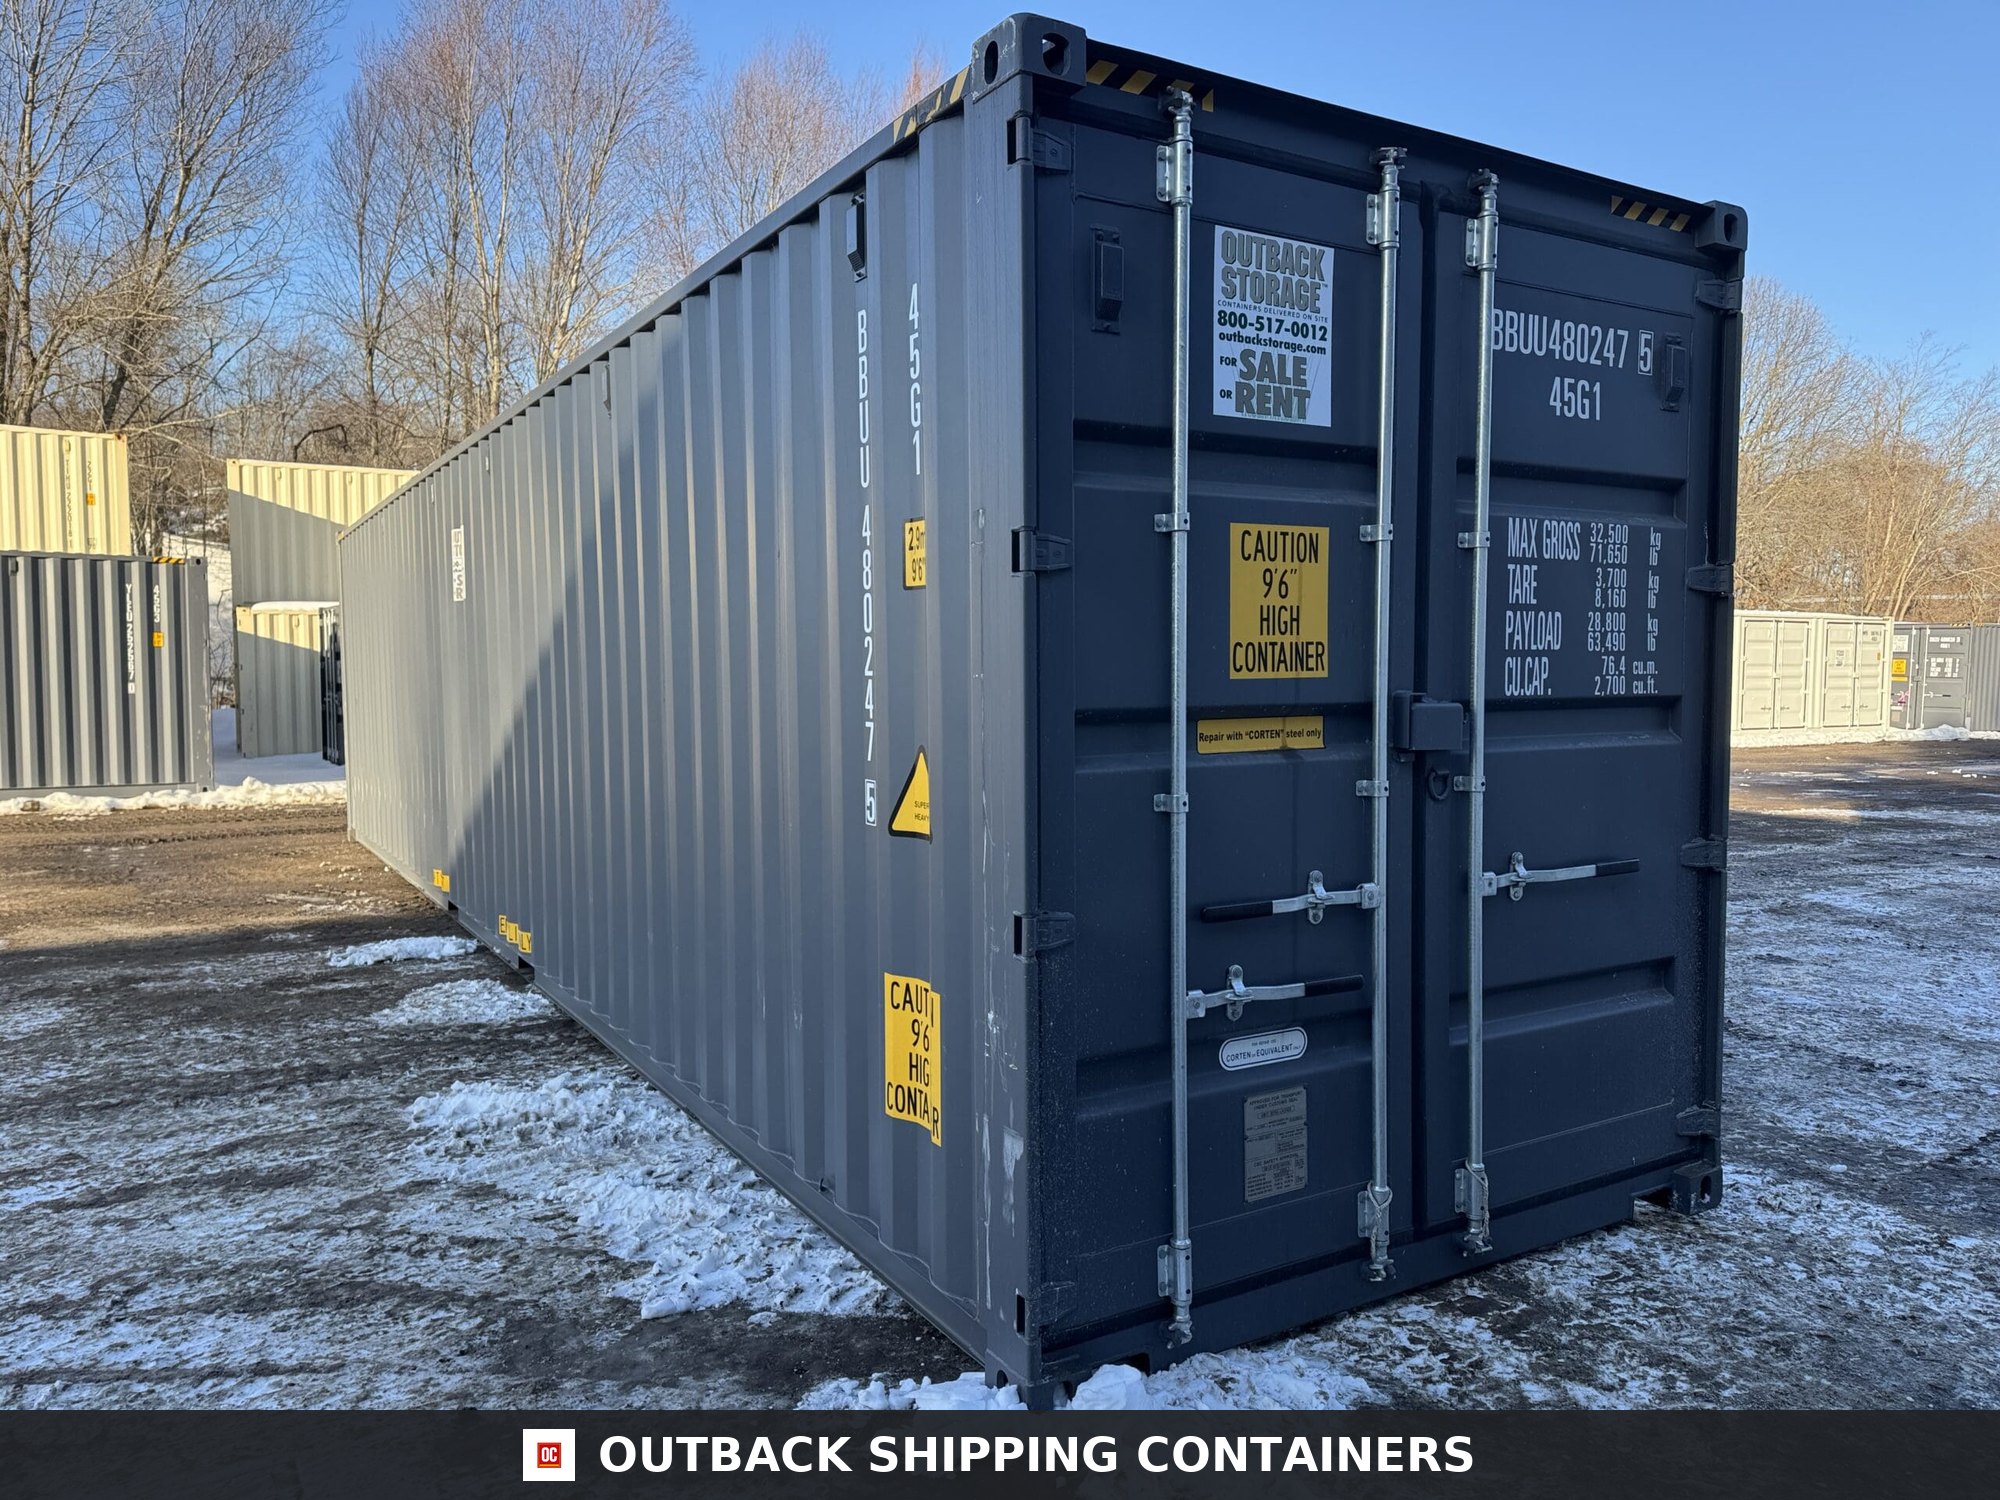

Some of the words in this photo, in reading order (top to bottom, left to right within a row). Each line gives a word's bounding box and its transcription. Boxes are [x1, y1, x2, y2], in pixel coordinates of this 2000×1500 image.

[1221, 230, 1326, 282] OUTBACK
[1221, 265, 1321, 314] STORAGE
[1217, 300, 1261, 312] CONTAINERS
[1264, 307, 1300, 319] DELIVERED
[1303, 313, 1312, 321] ON
[1217, 310, 1328, 341] 800-517-0012
[1218, 331, 1327, 355] outbackstorage.com
[1639, 332, 1652, 373] 5
[908, 282, 922, 475] 45G1
[1219, 355, 1237, 367] FOR
[1239, 348, 1307, 388] SALE
[857, 309, 870, 488] BBUU
[1219, 389, 1233, 400] OR
[1235, 381, 1311, 420] RENT
[1549, 376, 1600, 420] 45G1
[1241, 530, 1320, 564] CAUTION
[1507, 517, 1538, 559] MAX
[1543, 519, 1581, 561] GROSS
[1590, 522, 1629, 544] 32,500
[1650, 527, 1662, 550] kg
[1590, 544, 1628, 564] 71,650
[1650, 547, 1658, 566] lb
[1262, 568, 1298, 599] 9'6"
[1507, 564, 1538, 604] TARE
[1596, 568, 1627, 588] 3,700
[1648, 570, 1660, 593] kg
[1595, 588, 1626, 609] 8,160
[1648, 590, 1656, 609] lb
[862, 504, 874, 761] 480247
[1260, 604, 1300, 636] HIGH
[1505, 610, 1562, 651] PAYLOAD
[1588, 612, 1626, 632] 28,800
[1647, 613, 1658, 636] kg
[1232, 642, 1325, 673] CONTAINER
[1588, 632, 1626, 652] 63,490
[1647, 633, 1656, 651] lb
[1505, 656, 1552, 696] CU.CAP.
[1602, 656, 1626, 675] 76.4
[1632, 661, 1658, 674] cu.m.
[1594, 676, 1626, 696] 2,700
[1632, 676, 1658, 694] cu.ft.
[1199, 732, 1224, 743] Repair
[1226, 731, 1243, 740] with
[1286, 728, 1304, 738] steel
[1306, 728, 1322, 739] only
[865, 780, 876, 825] 5
[908, 1052, 930, 1087] HIG
[1226, 1051, 1251, 1063] CORTEN
[1256, 1043, 1294, 1057] EQUIVALENT
